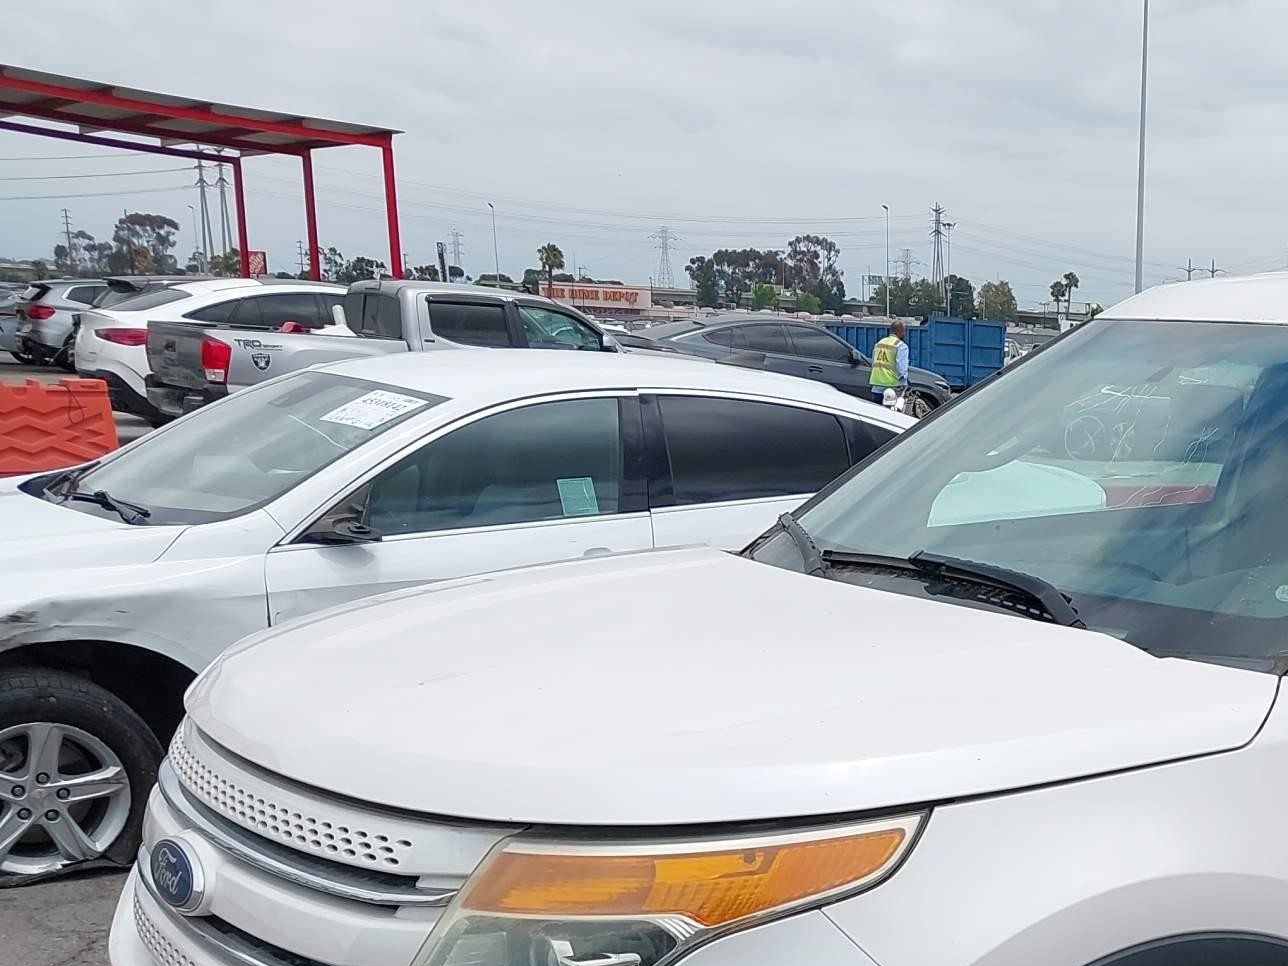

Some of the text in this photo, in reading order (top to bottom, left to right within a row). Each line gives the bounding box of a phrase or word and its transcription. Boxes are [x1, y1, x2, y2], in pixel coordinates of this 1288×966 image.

[542, 287, 566, 299] THE
[602, 290, 639, 303] DEPOT
[153, 847, 182, 895] Ford
